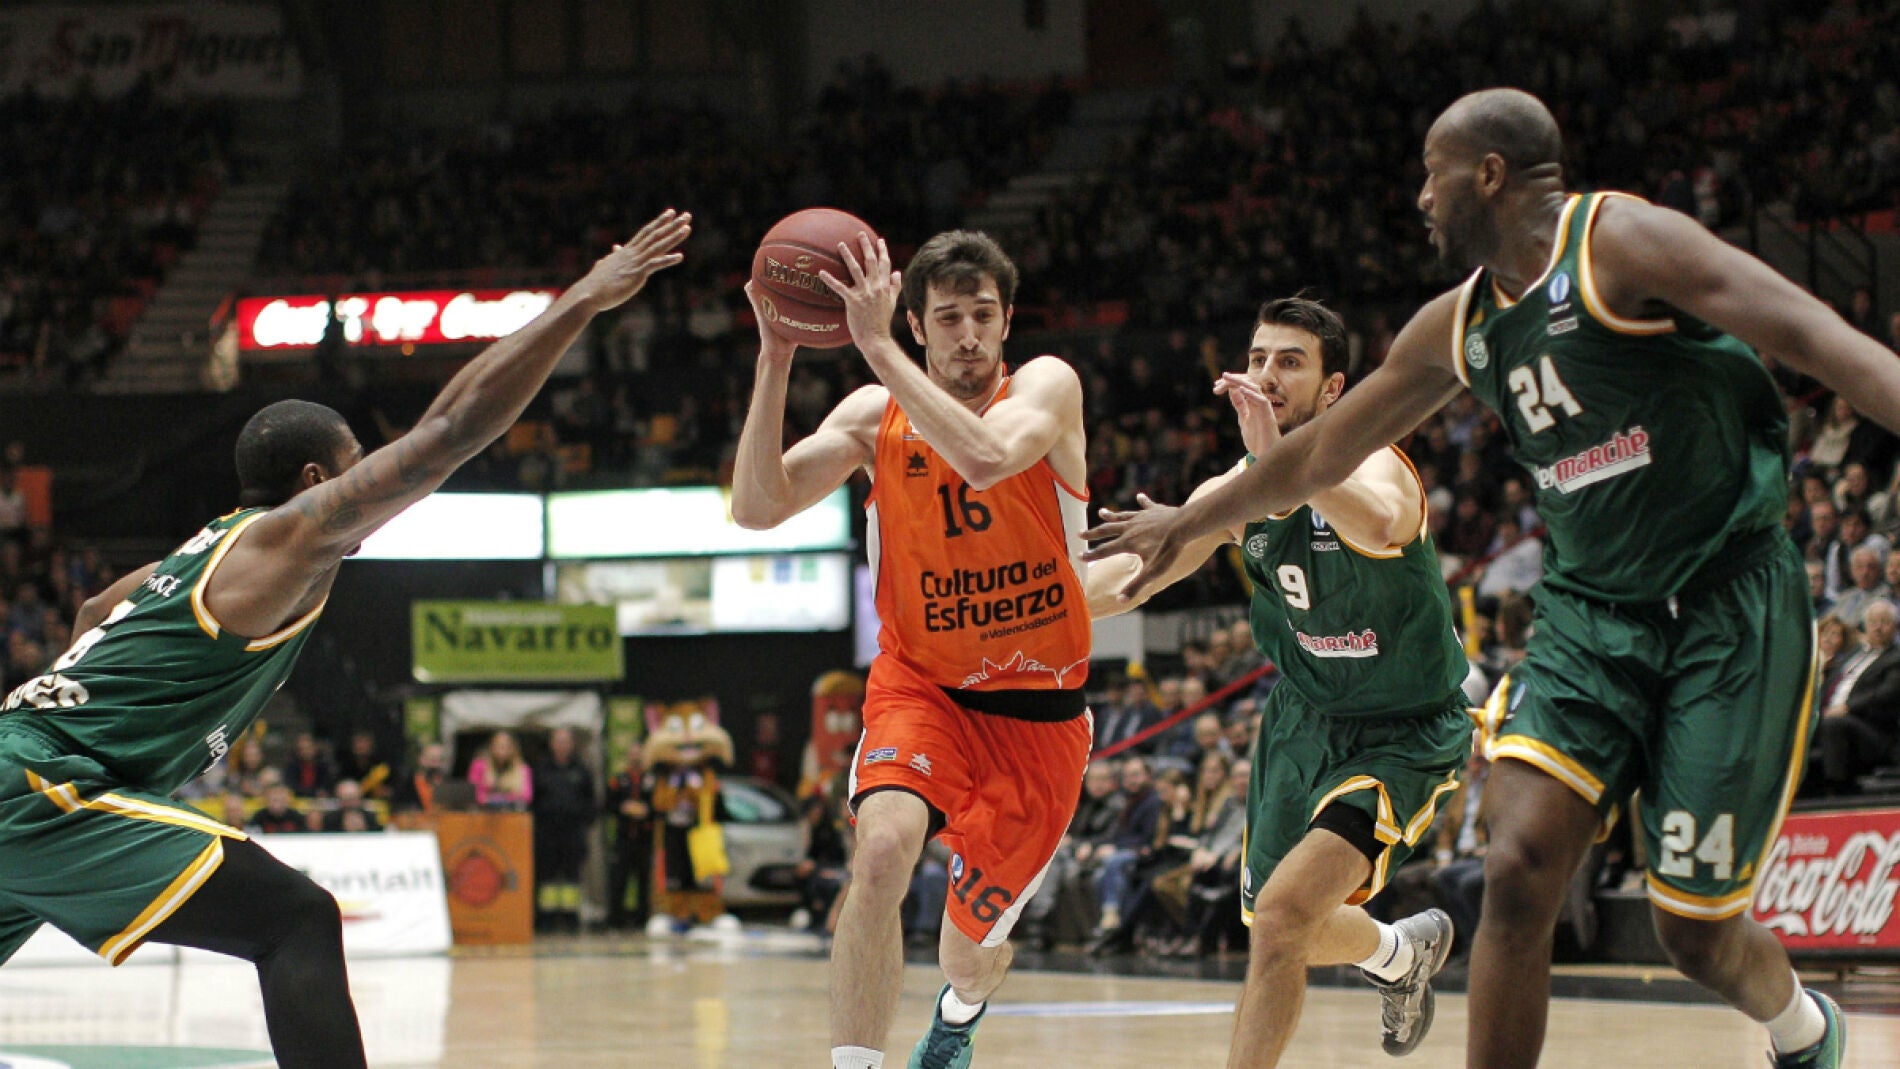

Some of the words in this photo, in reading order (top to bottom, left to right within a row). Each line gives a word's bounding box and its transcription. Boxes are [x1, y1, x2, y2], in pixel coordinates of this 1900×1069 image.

[1509, 355, 1583, 434] 24
[937, 481, 993, 538] 16
[920, 560, 1029, 600] Cultura
[1032, 557, 1058, 581] del
[1276, 564, 1310, 610] 9
[424, 610, 614, 651] Navarro
[924, 582, 1065, 633] Esfuerzo
[1657, 810, 1736, 880] 24
[954, 867, 1013, 924] 16
